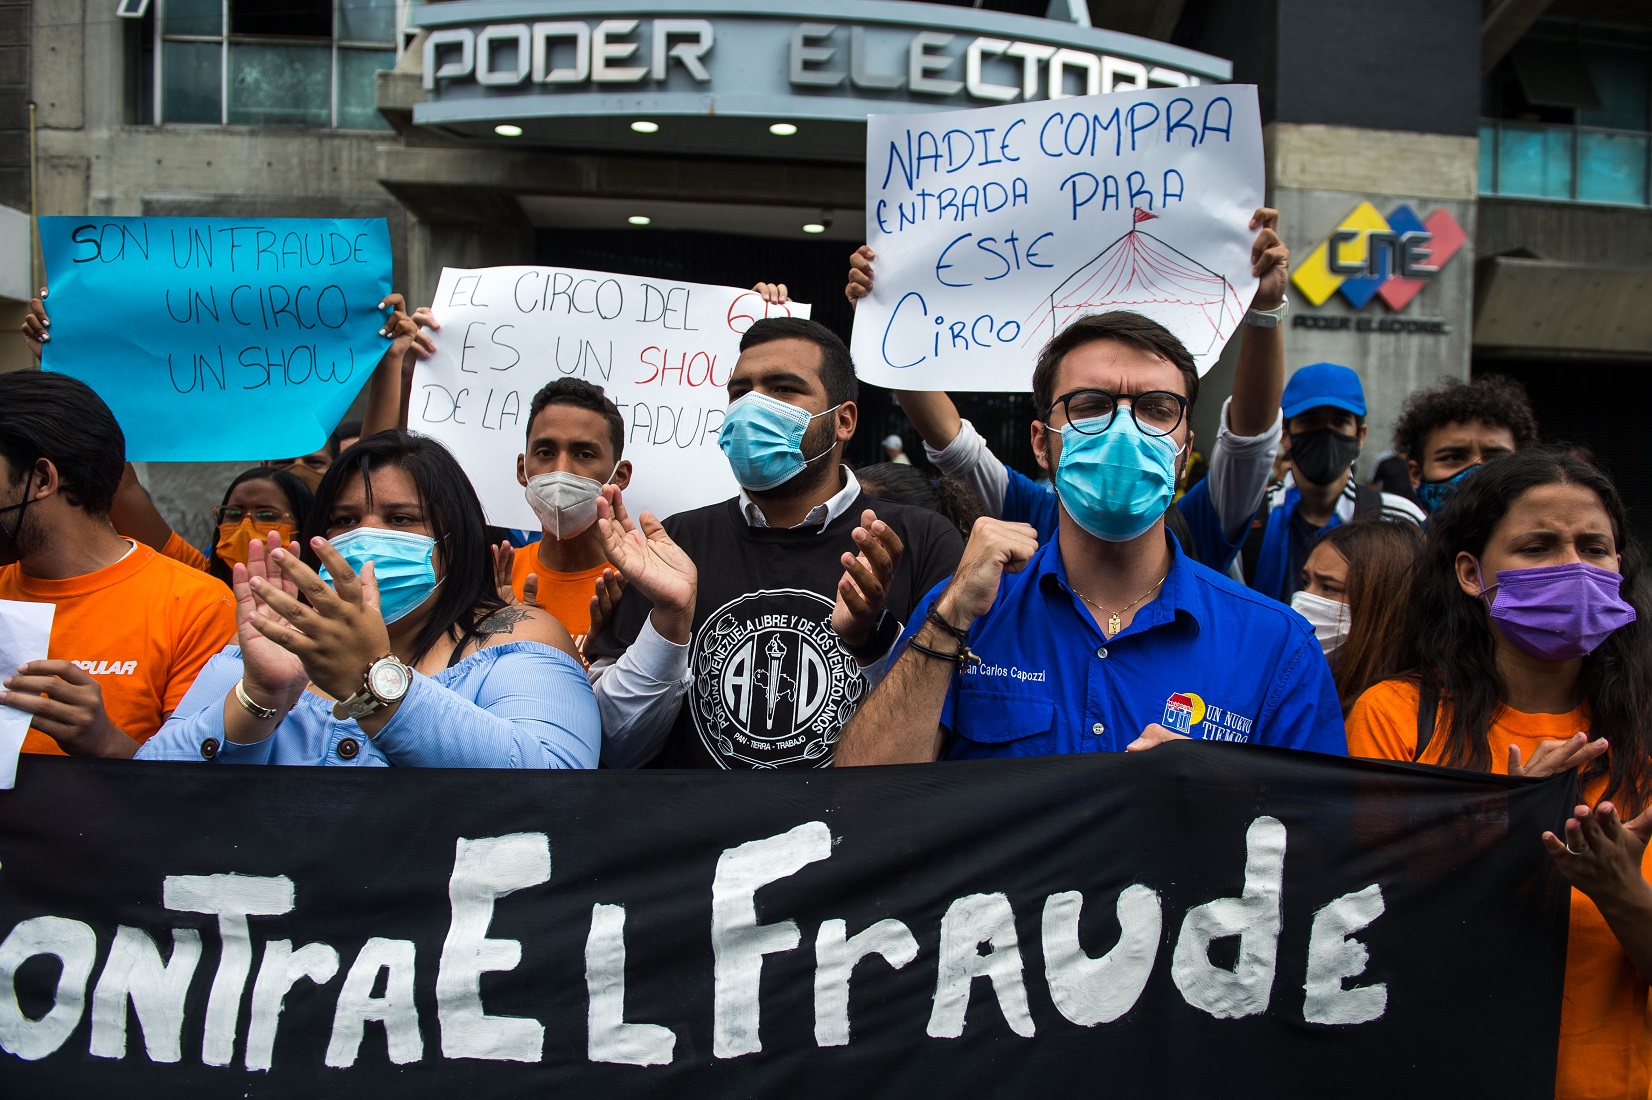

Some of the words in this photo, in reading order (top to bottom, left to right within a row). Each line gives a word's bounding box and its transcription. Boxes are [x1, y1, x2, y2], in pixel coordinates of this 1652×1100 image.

[422, 19, 715, 90] PODER
[789, 22, 1200, 101] ELECTOR
[882, 119, 1026, 191] NADIE
[1039, 96, 1233, 159] COMPRA
[1060, 168, 1184, 221] PARA
[71, 222, 149, 264] SON
[219, 226, 368, 272] FRAUDE
[165, 284, 219, 324] UN
[230, 284, 348, 330] CIRCO
[448, 274, 489, 308] EL
[513, 271, 624, 320] CIRCO
[635, 282, 699, 331] DEL
[168, 345, 225, 394] UN
[238, 345, 354, 390] SHOW
[461, 321, 520, 374] ES
[555, 336, 613, 382] UN
[421, 384, 469, 424] DE
[481, 388, 520, 430] LA
[755, 614, 789, 630] LIBRE
[789, 615, 799, 628] Y
[797, 617, 815, 634] DE
[811, 628, 834, 651] LOS
[711, 620, 756, 676] VENEZUELA
[711, 678, 720, 704] UNA
[811, 649, 845, 734] VENEZOLANOS
[979, 663, 1008, 677] Carlos
[1010, 666, 1046, 683] Capozzi
[711, 702, 730, 729] POR
[1206, 704, 1223, 723] UN
[1223, 710, 1253, 734] NUEVO
[733, 732, 748, 746] PAN
[749, 739, 771, 751] TIERRA
[775, 734, 807, 750] TRABAJO
[436, 831, 679, 1068] EL
